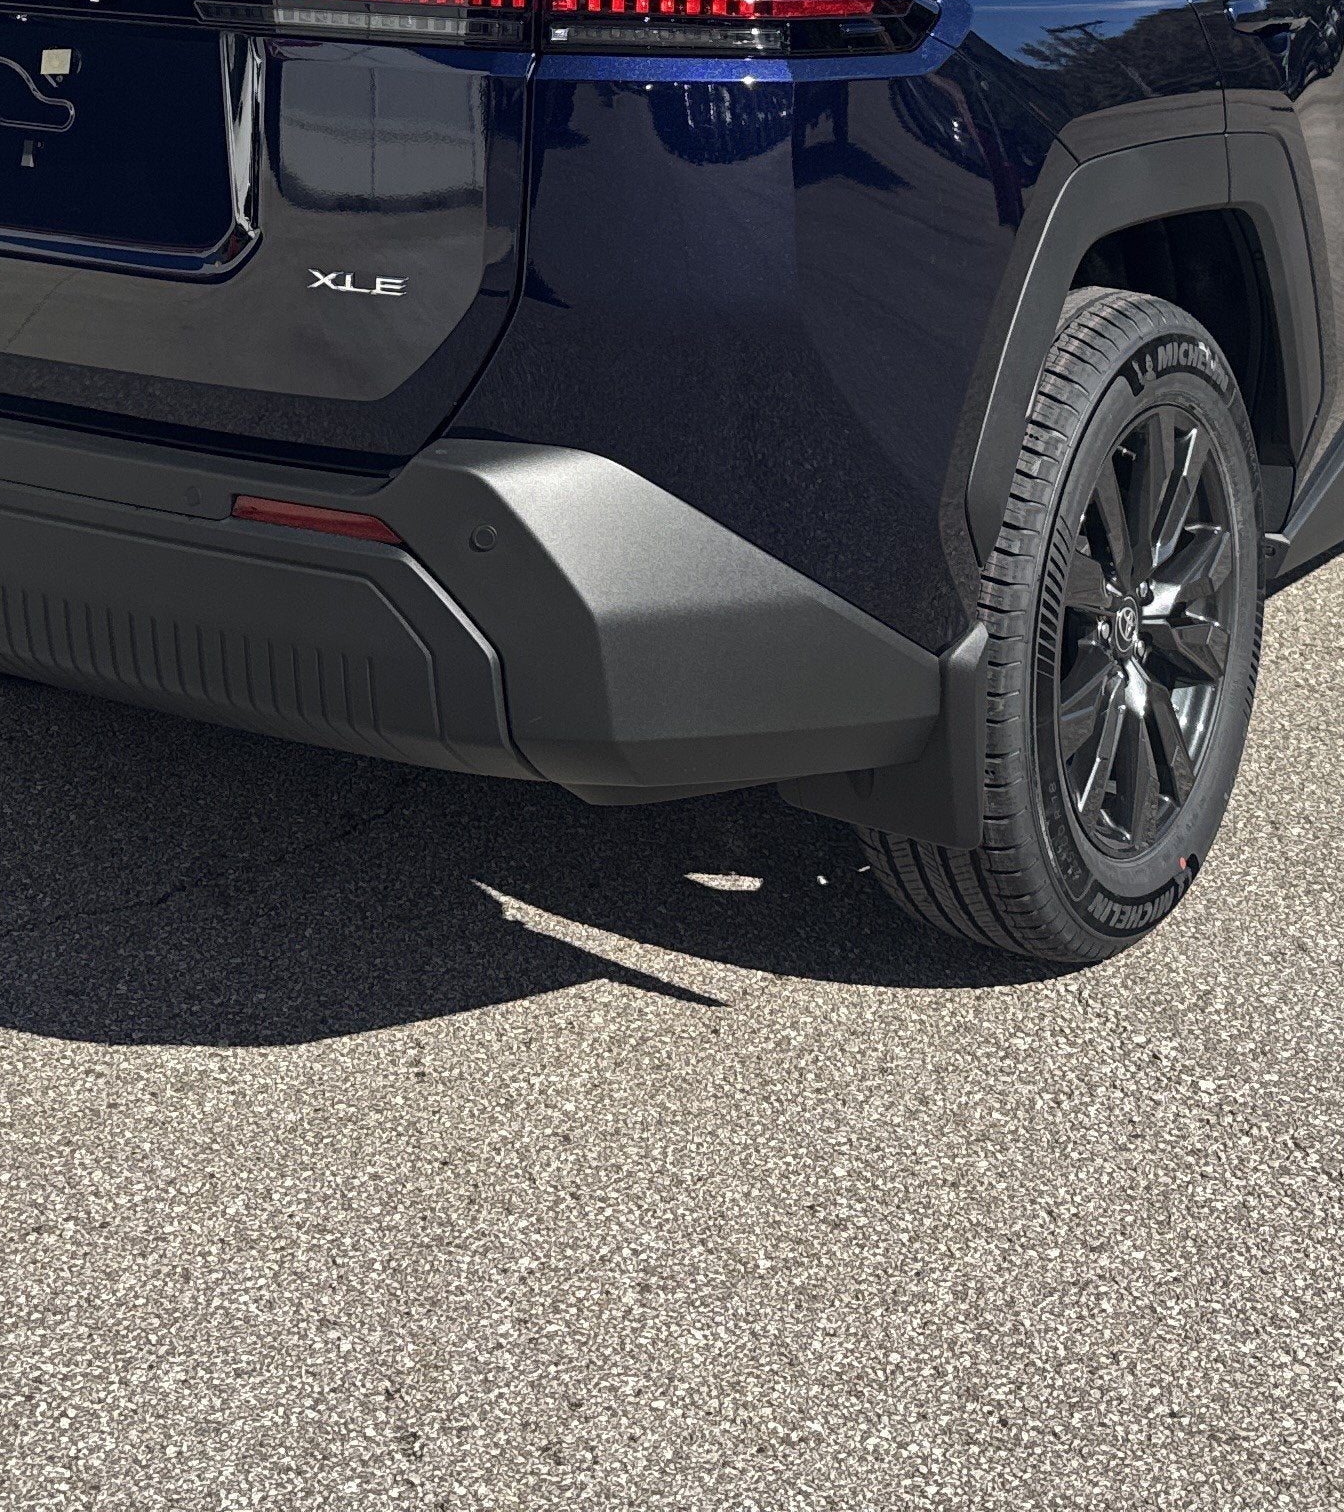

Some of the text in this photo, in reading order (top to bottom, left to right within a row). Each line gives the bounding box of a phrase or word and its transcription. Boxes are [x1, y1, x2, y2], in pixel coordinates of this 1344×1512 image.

[307, 268, 410, 297] XLE
[1157, 341, 1229, 393] MICHELIN
[1087, 885, 1176, 930] MICHELIN
